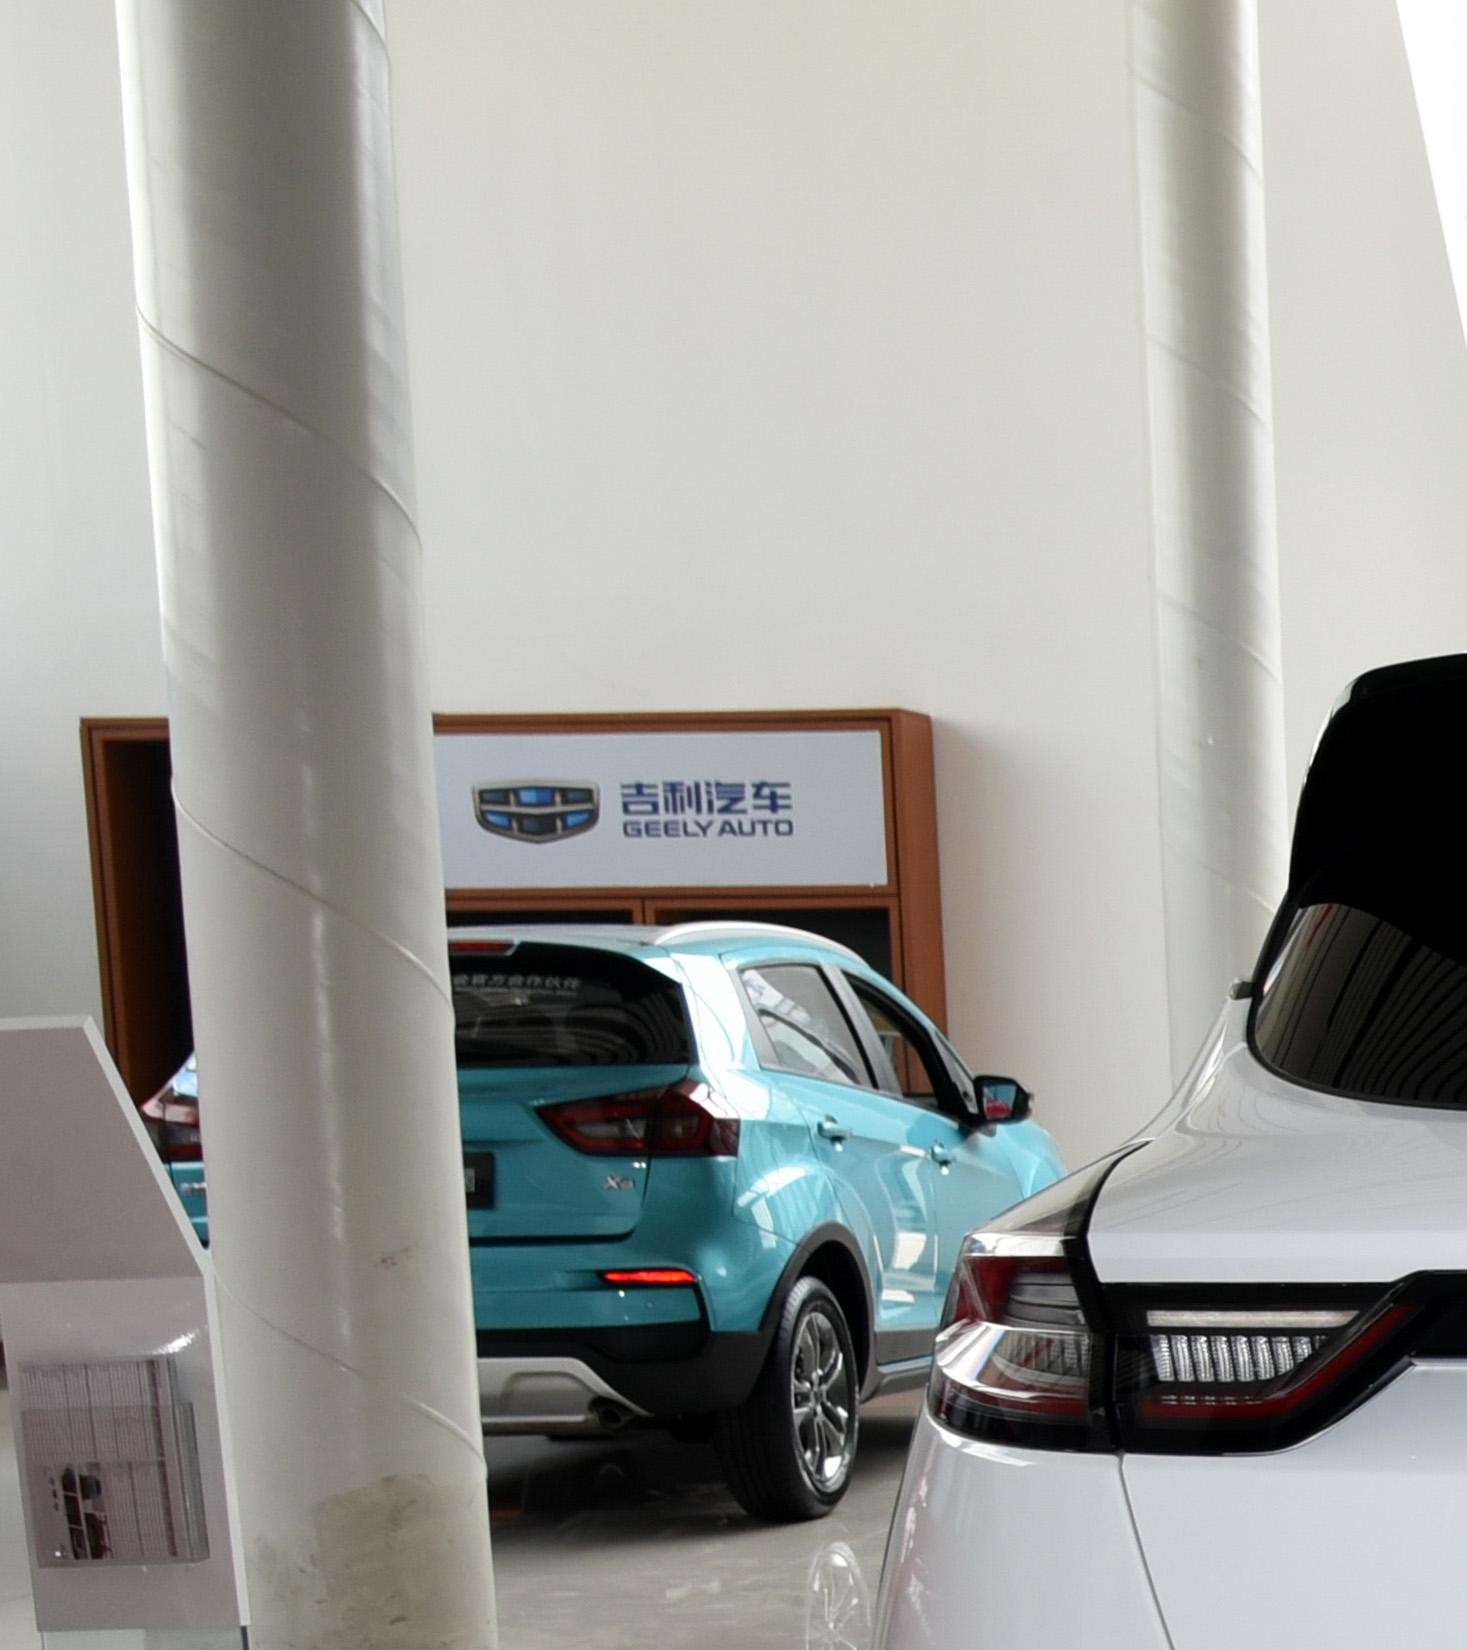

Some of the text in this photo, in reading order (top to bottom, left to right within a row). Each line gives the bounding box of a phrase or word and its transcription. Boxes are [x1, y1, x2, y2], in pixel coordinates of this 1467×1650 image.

[621, 780, 793, 816] 吉利汽车
[622, 819, 794, 839] GEELY AUTO
